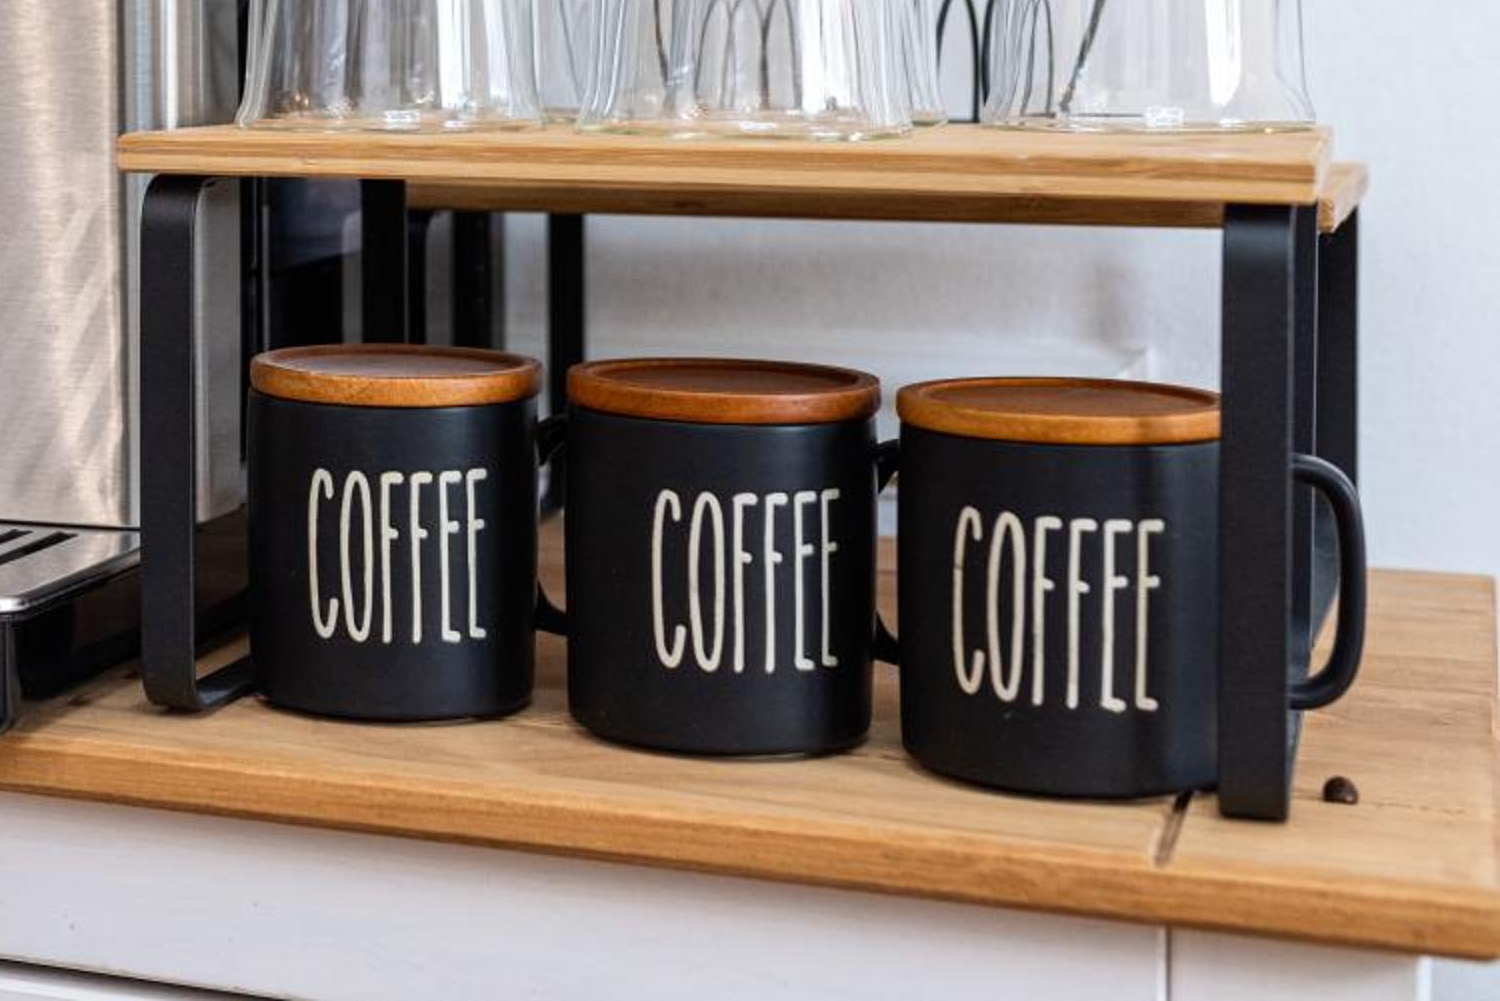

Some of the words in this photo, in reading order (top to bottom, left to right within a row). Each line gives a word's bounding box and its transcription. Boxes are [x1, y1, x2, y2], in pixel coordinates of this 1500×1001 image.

[307, 467, 488, 645] COFFEE
[651, 488, 840, 673] COFFEE
[952, 504, 1165, 712] COFFEE
